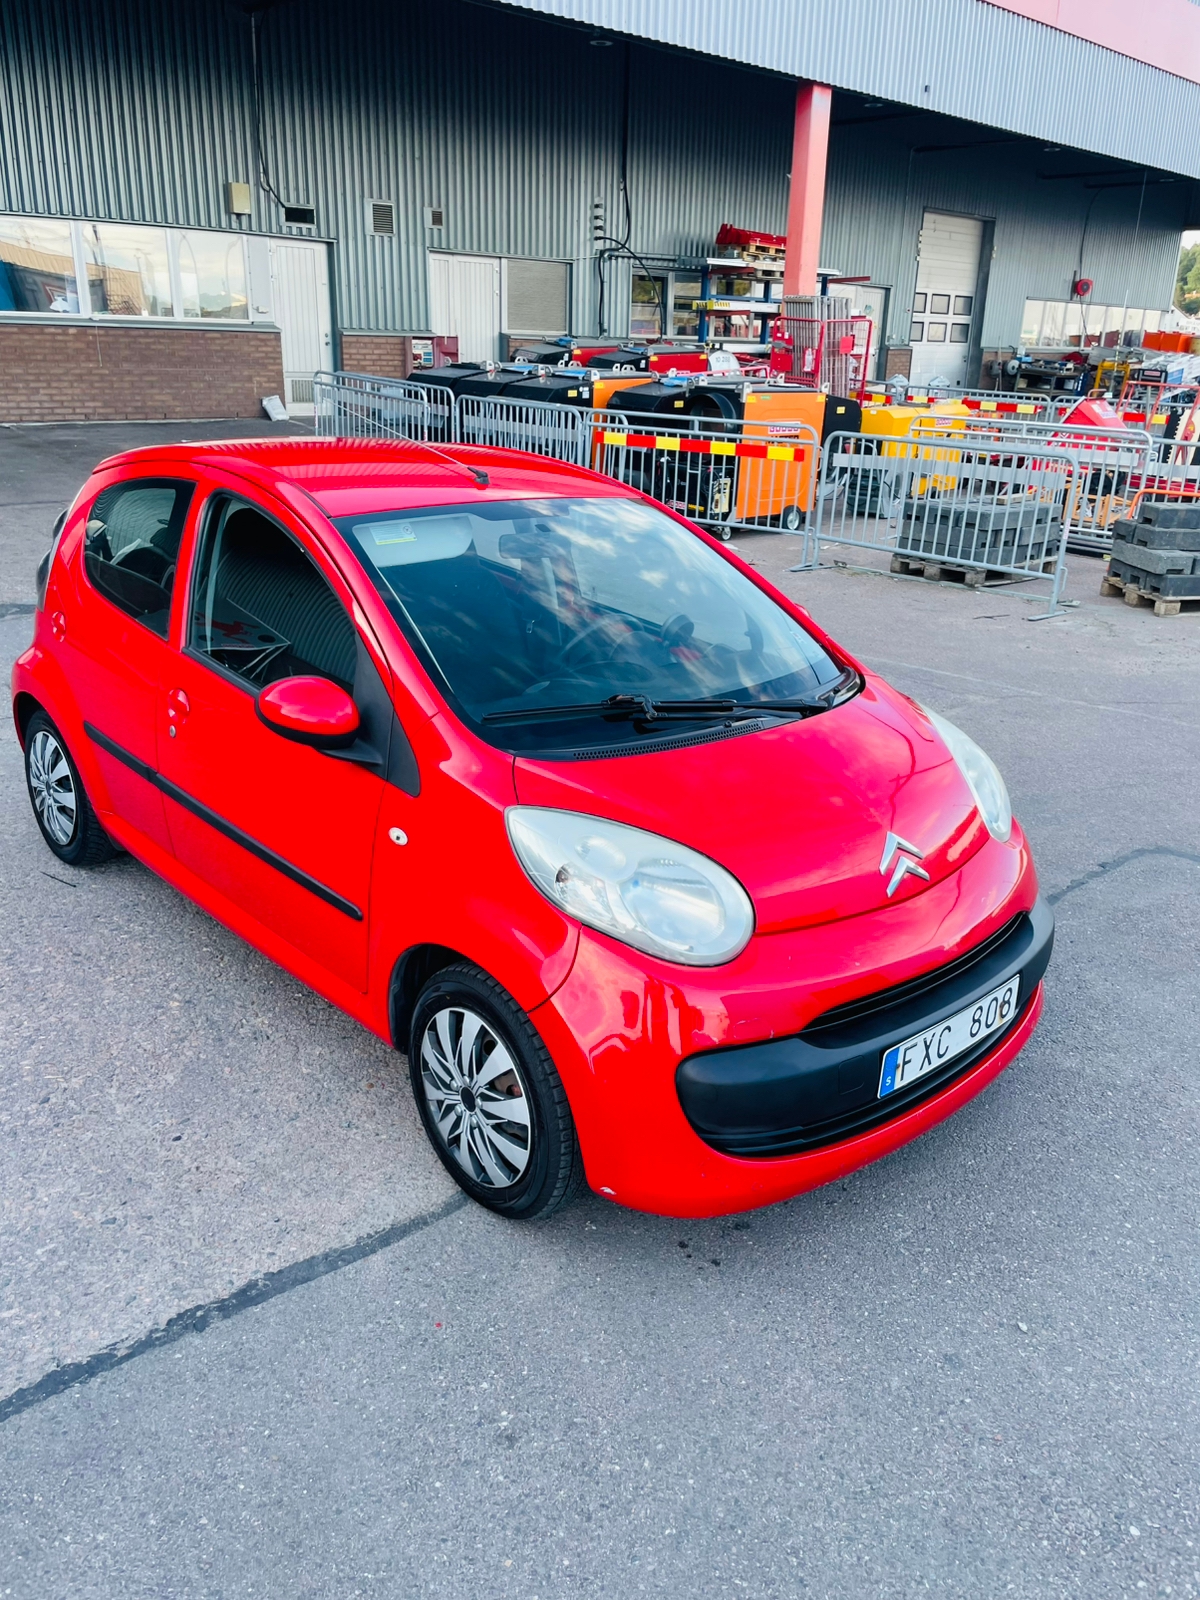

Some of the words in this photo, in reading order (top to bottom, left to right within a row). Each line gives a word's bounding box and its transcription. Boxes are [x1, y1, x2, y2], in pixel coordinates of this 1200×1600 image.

[900, 1025, 951, 1081] FXC
[969, 987, 1013, 1038] 808
[885, 1076, 892, 1086] S
